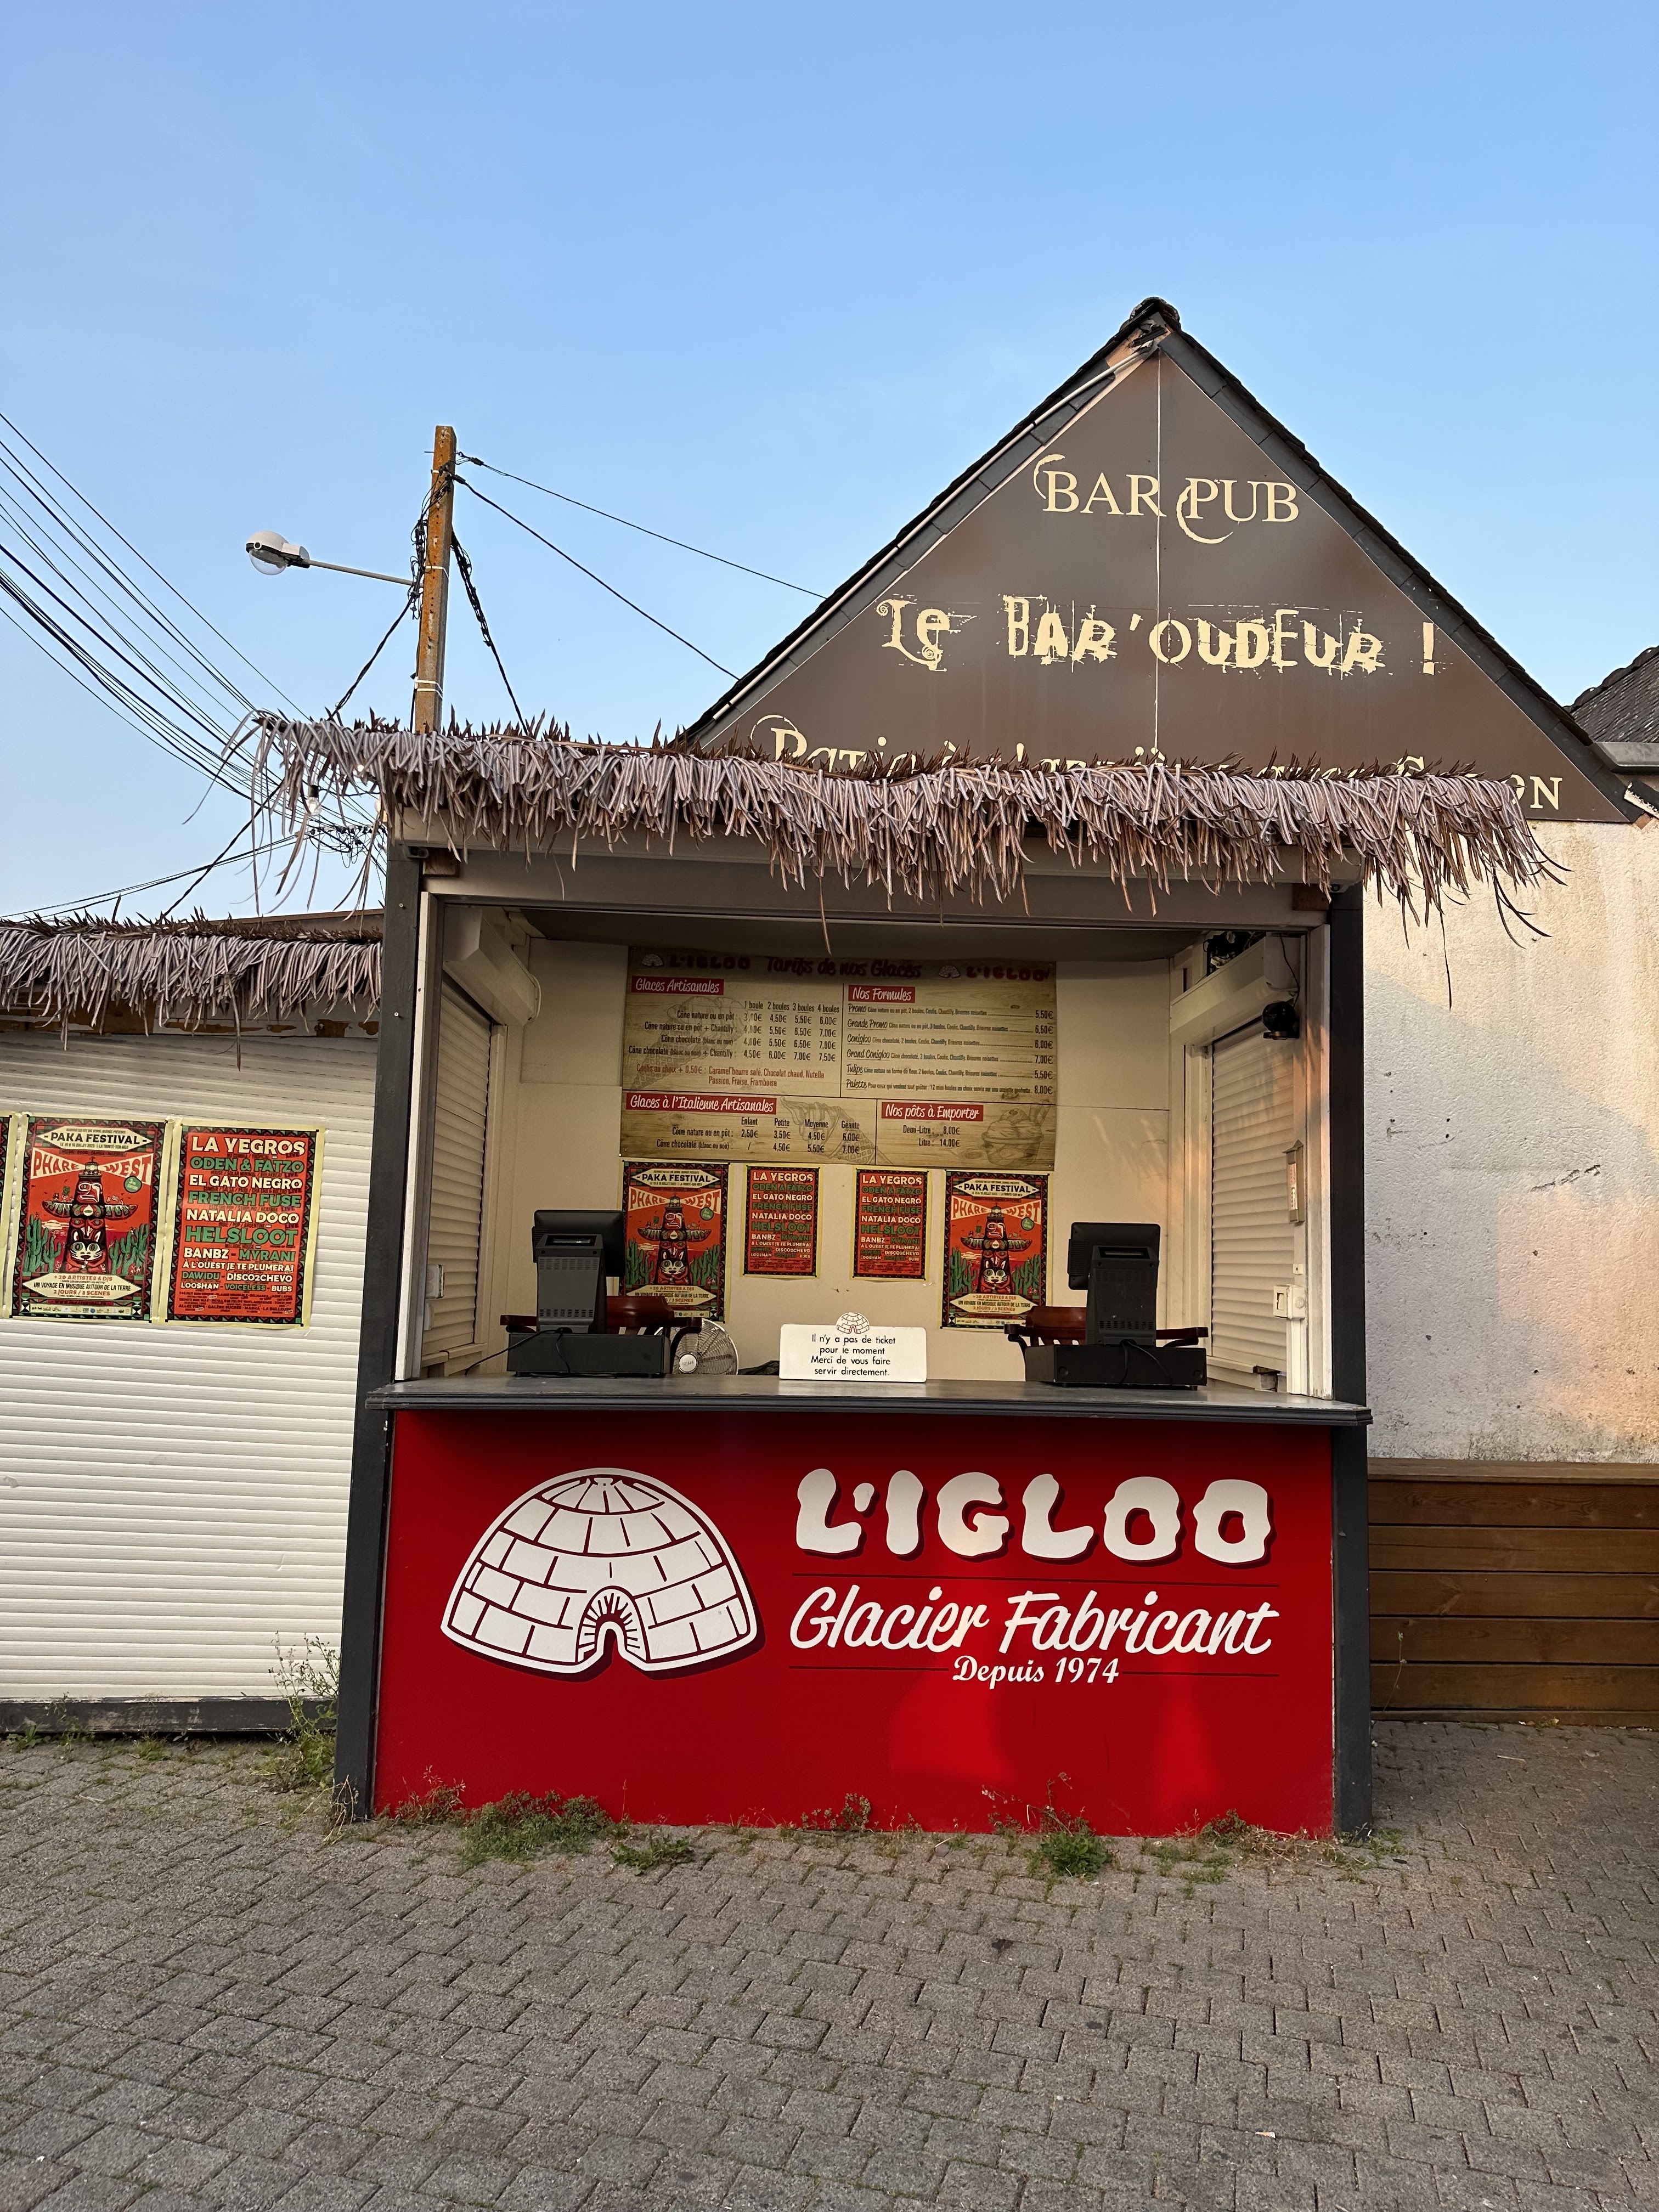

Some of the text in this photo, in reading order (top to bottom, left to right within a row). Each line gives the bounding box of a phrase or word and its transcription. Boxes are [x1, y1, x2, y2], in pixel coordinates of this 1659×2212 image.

[1043, 470, 1299, 523] BAR PUB
[636, 978, 720, 993] Glaces Artisanales
[853, 986, 912, 1001] Nos Formules
[749, 1001, 763, 1009] boule
[848, 1003, 867, 1013] Promo
[770, 1014, 787, 1023] 4,50€
[795, 1015, 812, 1024] 5,50€
[1036, 1010, 1053, 1019] 5,50€
[820, 1017, 837, 1025] 6,00€
[848, 1019, 888, 1029] Grande Promo
[1035, 1025, 1053, 1034] 6,50€
[847, 1034, 871, 1045] Conigloo
[1035, 1040, 1053, 1049] 6,00€
[847, 1049, 890, 1060] Grand Conigloo
[1035, 1055, 1053, 1064] 7,00€
[709, 1066, 730, 1075] Caramel
[764, 1068, 786, 1077] Chocolat
[788, 1070, 804, 1079] chaud,
[806, 1070, 824, 1079] Nutella
[847, 1064, 863, 1074] Tulipe
[1035, 1070, 1053, 1079] 5,50€
[709, 1076, 777, 1086] Passion, Fraise, Framboise
[847, 1079, 867, 1088] Palette
[1034, 1086, 1053, 1094] 8,00€
[630, 1095, 774, 1113] Glaces à l'Italienne Artisanales
[885, 1104, 979, 1121] Nos pôts à Emporter
[741, 1117, 758, 1125] Enfant
[775, 1118, 789, 1126] Petite
[805, 1119, 828, 1129] Moyenne
[673, 1126, 685, 1136] Cône
[741, 1129, 758, 1138] 2,50€
[774, 1130, 791, 1139] 3,50€
[944, 1126, 960, 1135] 8,00€
[50, 1132, 140, 1144] PAKA FESTIVAL
[808, 1132, 825, 1141] 4,50€
[843, 1133, 860, 1142] 6,00€
[192, 1136, 305, 1155] LA YEGROS
[919, 1138, 930, 1146] Litre
[940, 1139, 960, 1147] 14,00€
[33, 1151, 151, 1182] PHARE WEST
[191, 1156, 304, 1172] ODEN & FATZO
[189, 1175, 302, 1189] EL GATO NEGRO
[771, 1173, 813, 1181] YEGROS
[188, 1192, 301, 1207] FRENCH FUSE
[187, 1209, 299, 1223] NATALIA DOCO
[752, 1222, 812, 1232] HELSLOOT
[185, 1226, 298, 1245] HELSLOOT
[184, 1248, 295, 1261] BANBZ MYRANI
[183, 1259, 189, 1268] À
[227, 1262, 235, 1271] JE
[182, 1272, 293, 1283] DAWIDU DISCO2CHEVO
[812, 1334, 816, 1342] Il
[820, 1335, 831, 1344] n'y
[844, 1338, 858, 1346] pas
[820, 1347, 838, 1356] pour
[843, 1345, 849, 1353] le
[872, 1356, 890, 1365] faire
[815, 1367, 890, 1376] servir directement.
[796, 1468, 1277, 1566] L'IGLOO
[789, 1584, 1280, 1655] Glacier Fabricant
[952, 1655, 1120, 1689] Depuis 1974
